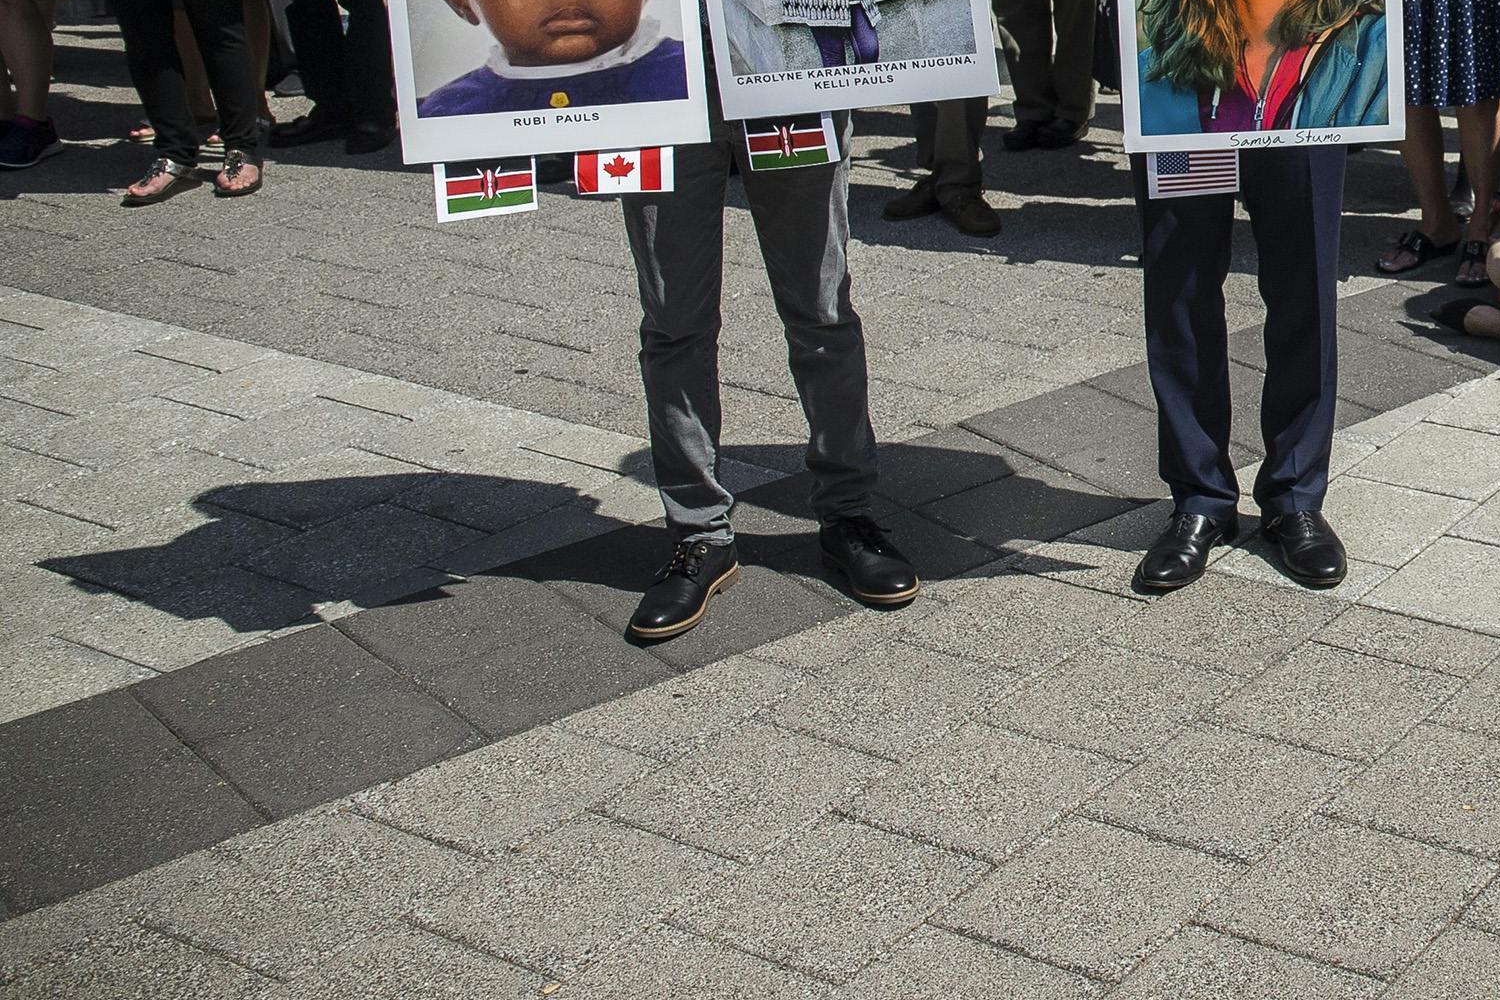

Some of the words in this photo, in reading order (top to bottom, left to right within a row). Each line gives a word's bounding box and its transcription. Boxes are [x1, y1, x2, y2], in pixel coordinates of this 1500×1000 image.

[736, 71, 803, 86] CAROLYNE
[807, 65, 871, 79] KARANJA,
[874, 61, 907, 73] RYAN
[911, 55, 977, 69] NJUGUNA,
[814, 78, 850, 90] KELLI
[854, 74, 894, 86] PAULS
[513, 116, 546, 127] RUBI
[556, 112, 600, 123] PAULS
[1230, 133, 1285, 147] Samya
[1294, 129, 1342, 144] Stumo
